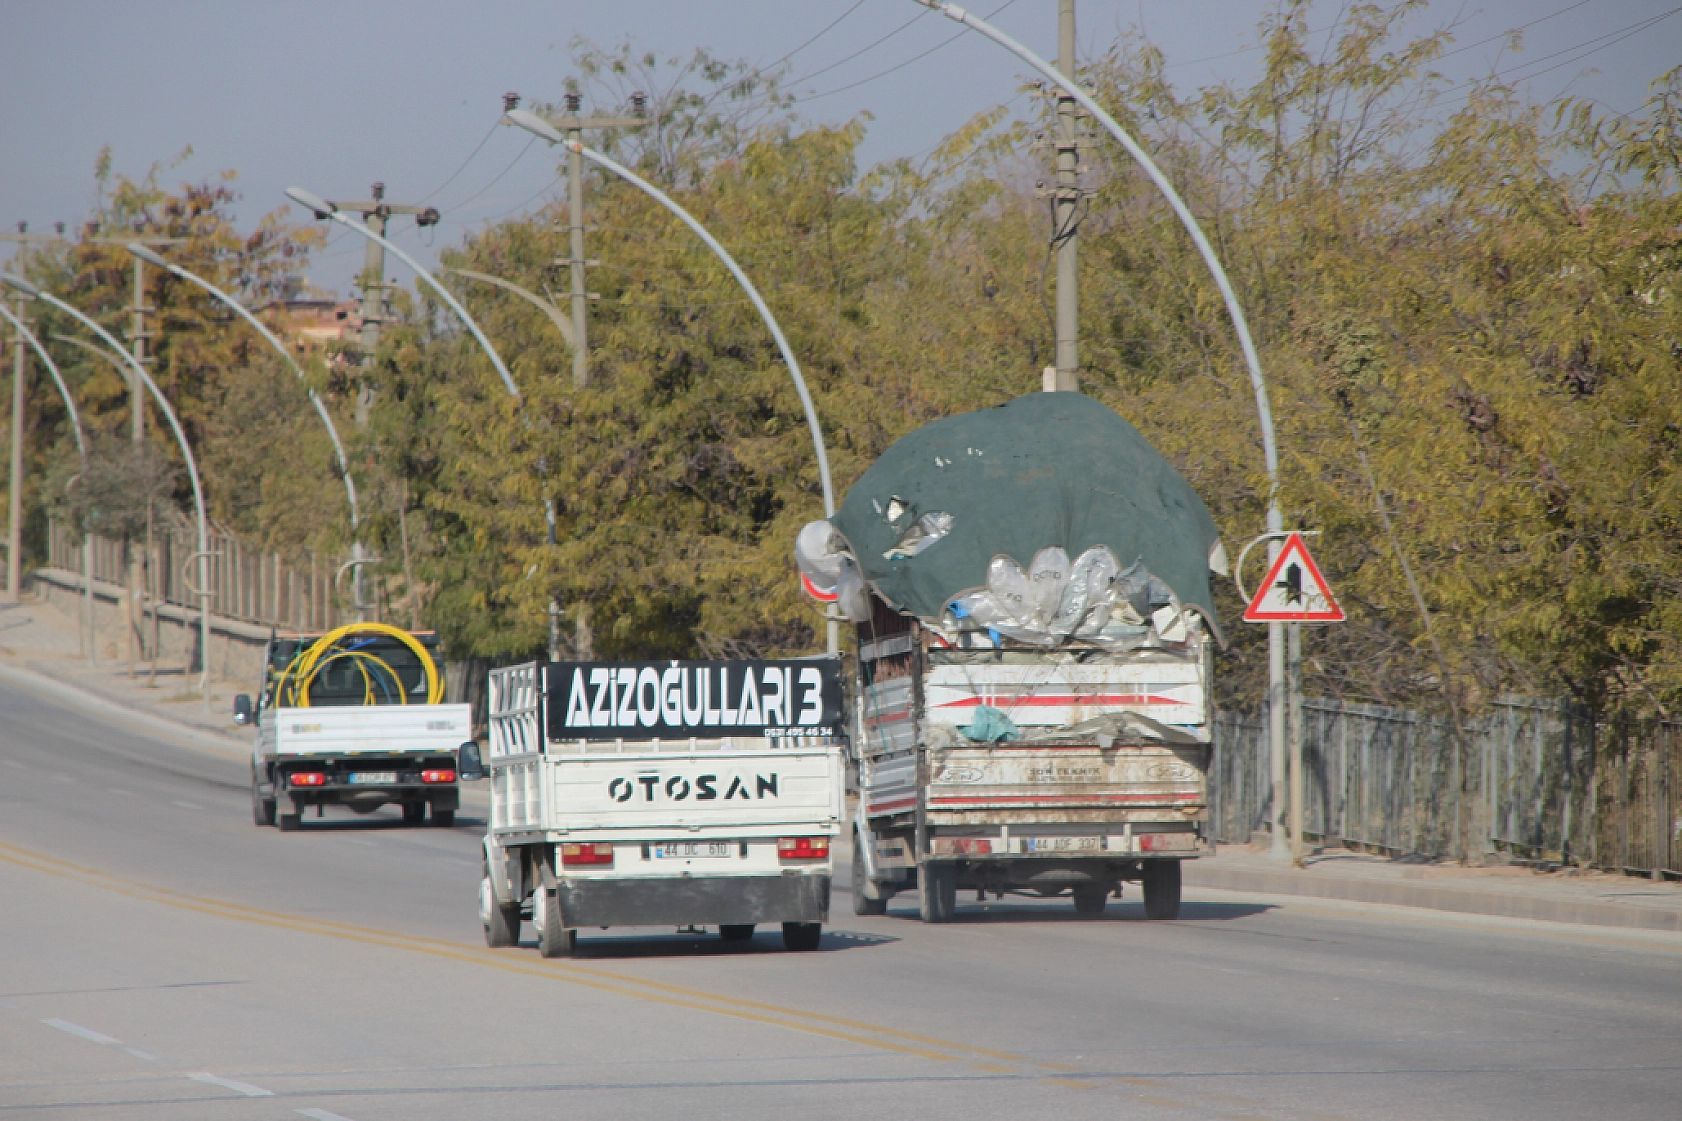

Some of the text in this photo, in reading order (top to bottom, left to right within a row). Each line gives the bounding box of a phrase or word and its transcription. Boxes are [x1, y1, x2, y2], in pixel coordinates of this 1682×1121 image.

[798, 667, 823, 726] 3
[608, 772, 778, 802] OTOSAN
[664, 842, 678, 856] 44
[708, 842, 727, 855] 610
